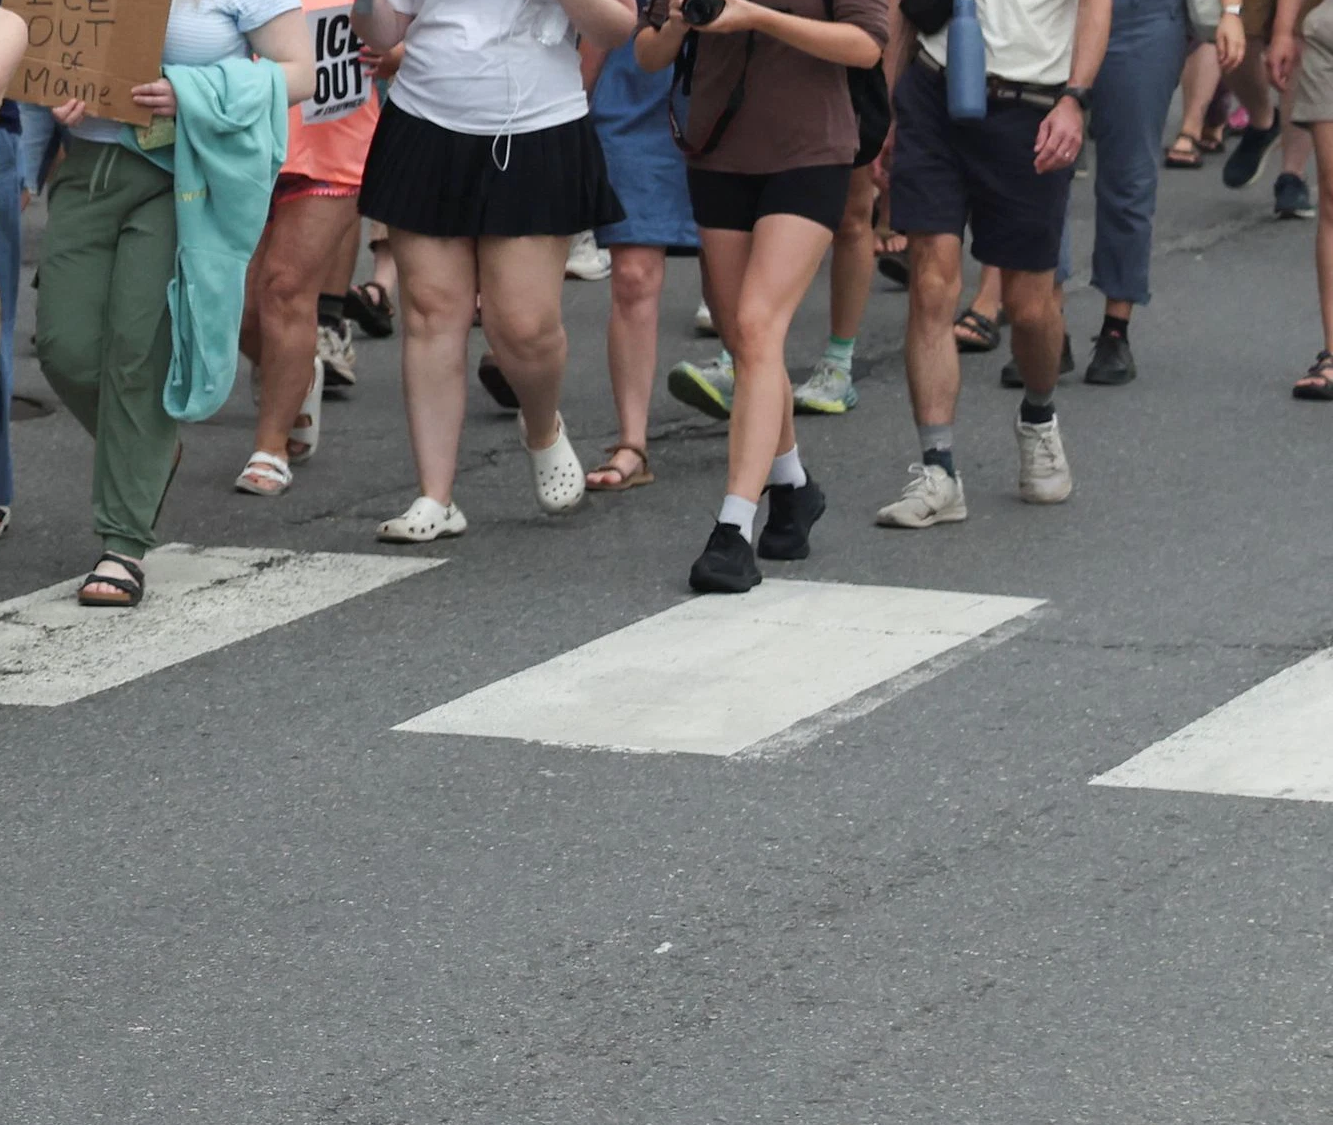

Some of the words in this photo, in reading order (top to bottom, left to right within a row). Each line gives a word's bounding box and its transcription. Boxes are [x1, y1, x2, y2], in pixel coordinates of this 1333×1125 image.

[27, 15, 116, 47] OUT
[23, 67, 112, 107] Maine
[313, 57, 362, 105] OUT
